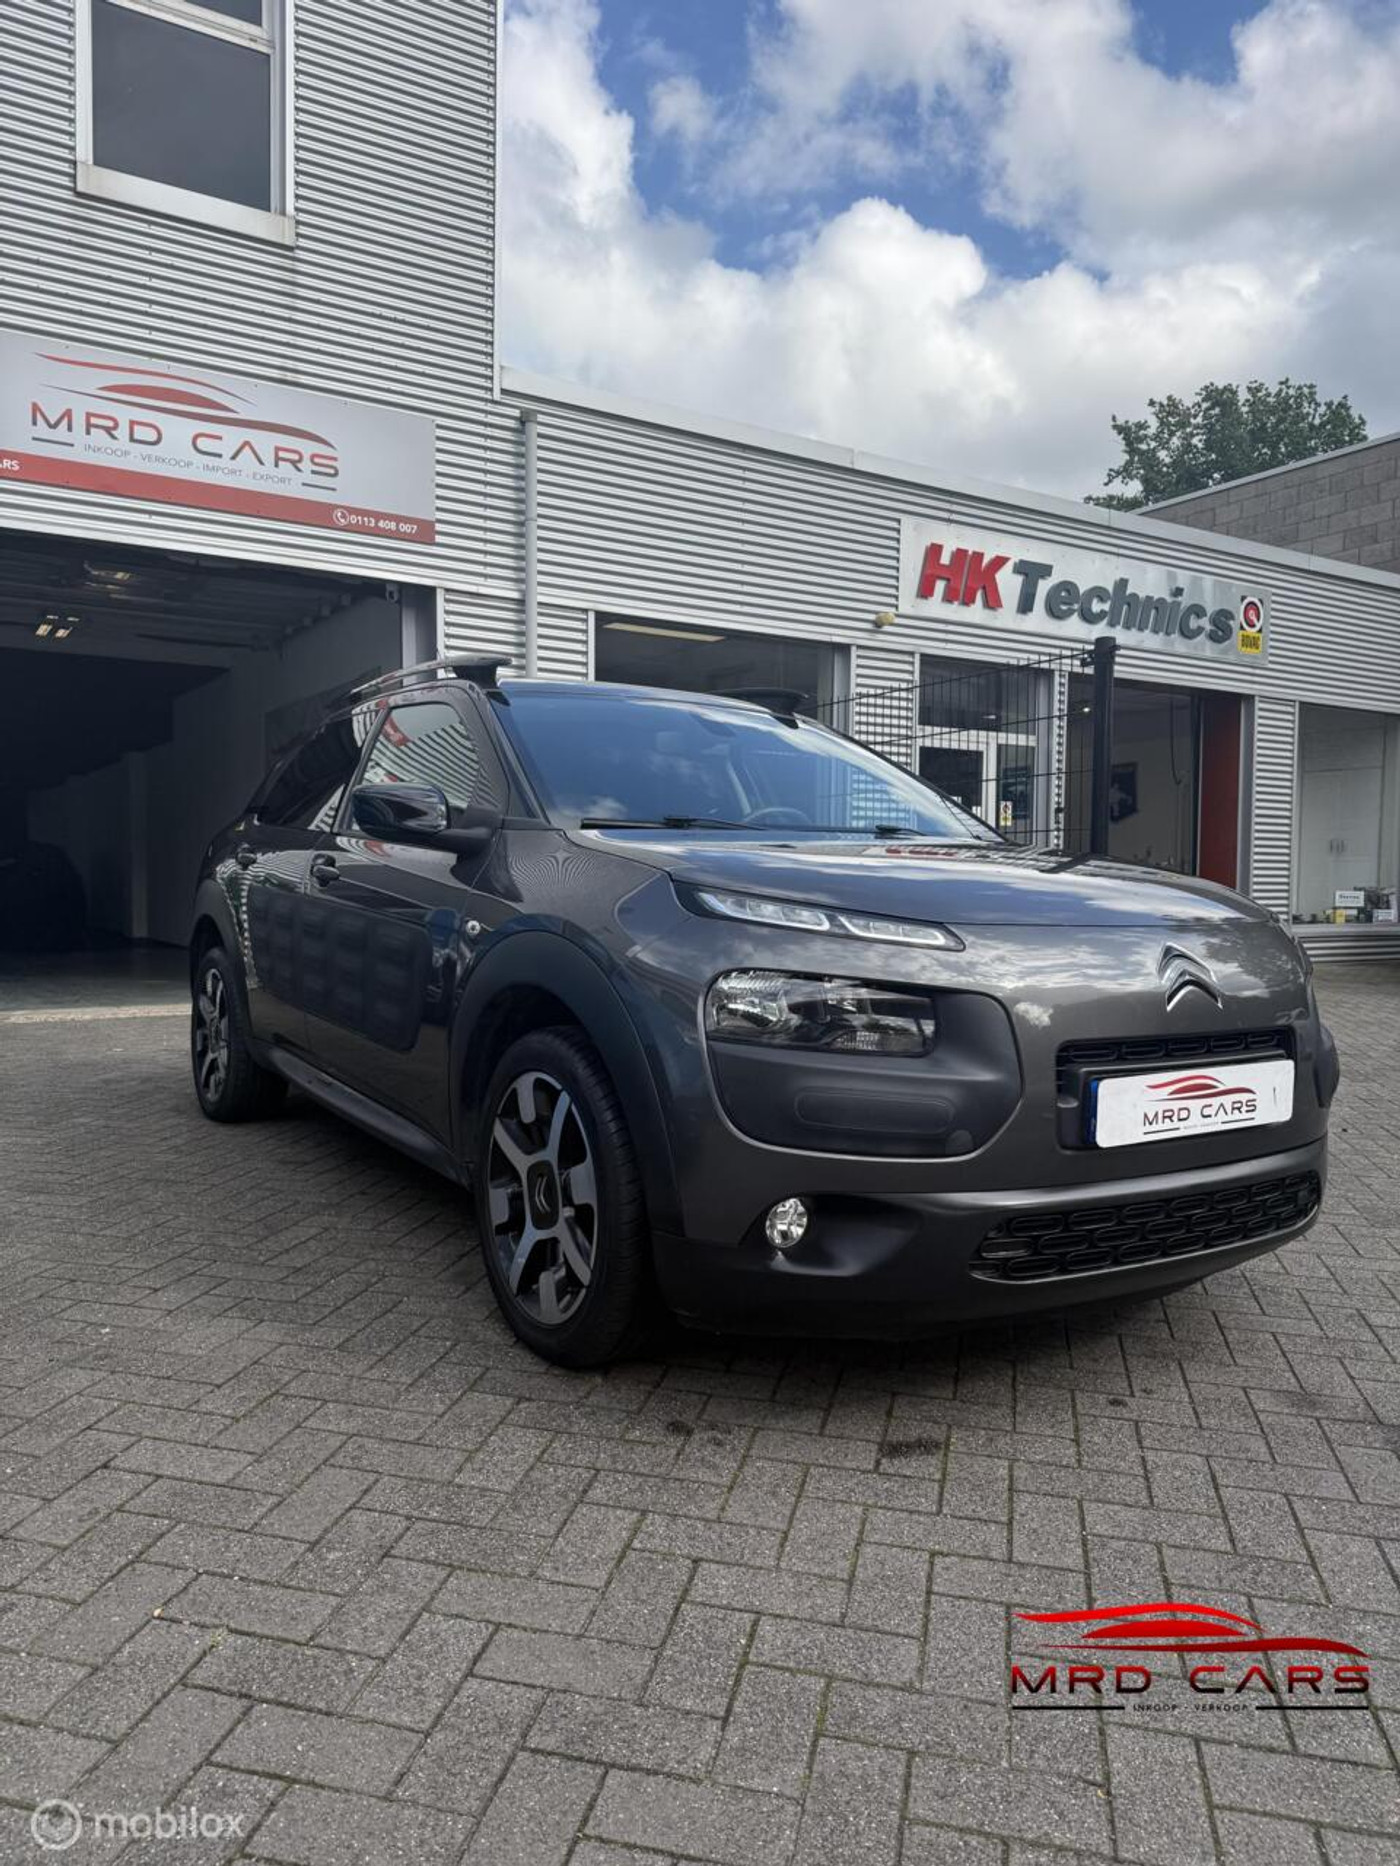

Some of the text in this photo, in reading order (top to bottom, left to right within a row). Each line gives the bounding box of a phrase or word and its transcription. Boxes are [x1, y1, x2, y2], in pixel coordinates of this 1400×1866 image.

[31, 401, 340, 479] MRD CARS
[0, 459, 20, 471] RS
[84, 443, 131, 458] INKOOP
[140, 453, 195, 468] VERKOOP
[202, 463, 243, 477] IMPORT
[252, 471, 293, 486] EXPORT
[350, 514, 417, 534] 0113 408 007
[917, 542, 1236, 644] HK Technics
[1143, 1107, 1191, 1127] MRD
[1200, 1099, 1257, 1119] CARS
